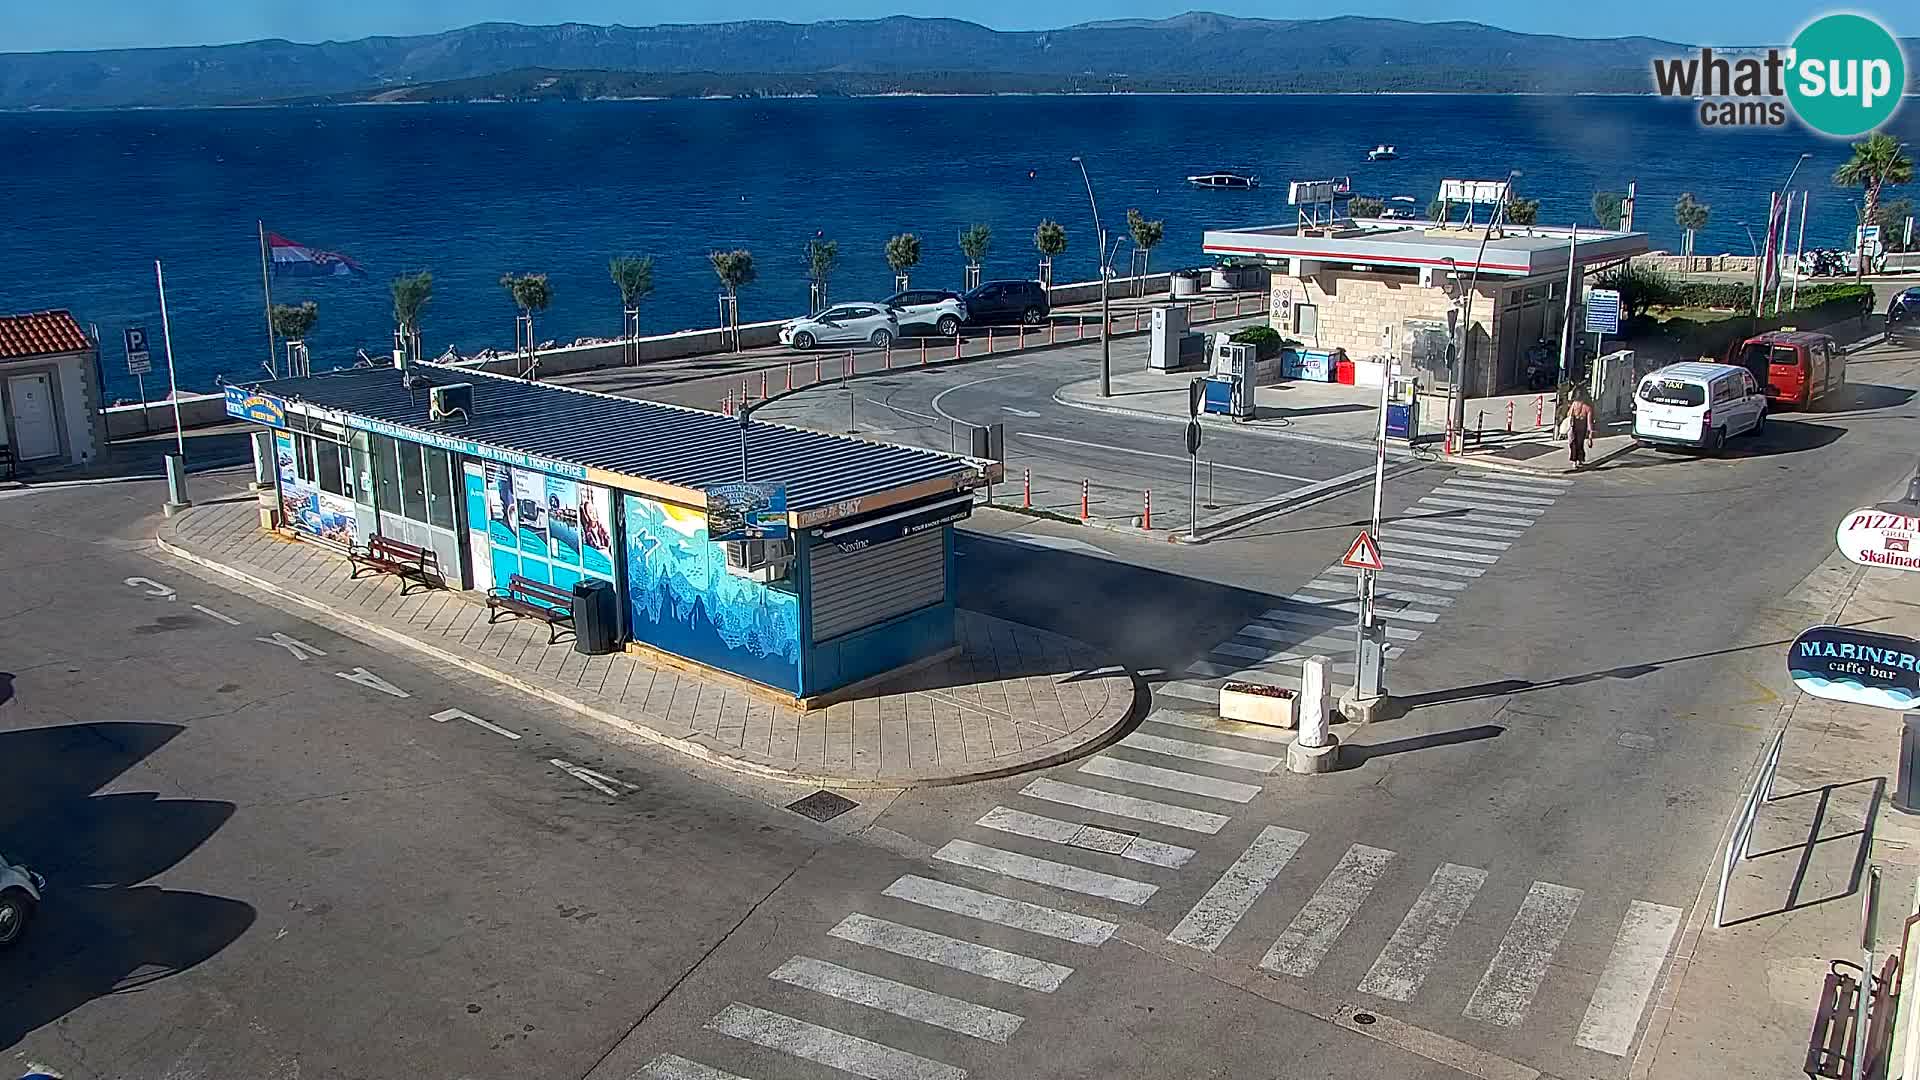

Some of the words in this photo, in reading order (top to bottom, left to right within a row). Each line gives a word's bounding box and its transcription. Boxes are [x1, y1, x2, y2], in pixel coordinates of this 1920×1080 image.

[130, 331, 142, 349] P
[1664, 381, 1684, 389] TAXI
[478, 445, 494, 458] BUS
[494, 448, 525, 463] STATION
[528, 455, 553, 469] TICKET
[556, 463, 582, 477] OFFICE
[1848, 515, 1920, 532] PIZZE
[838, 539, 870, 554] Novine
[1829, 661, 1865, 675] caffe
[1870, 665, 1897, 680] bar
